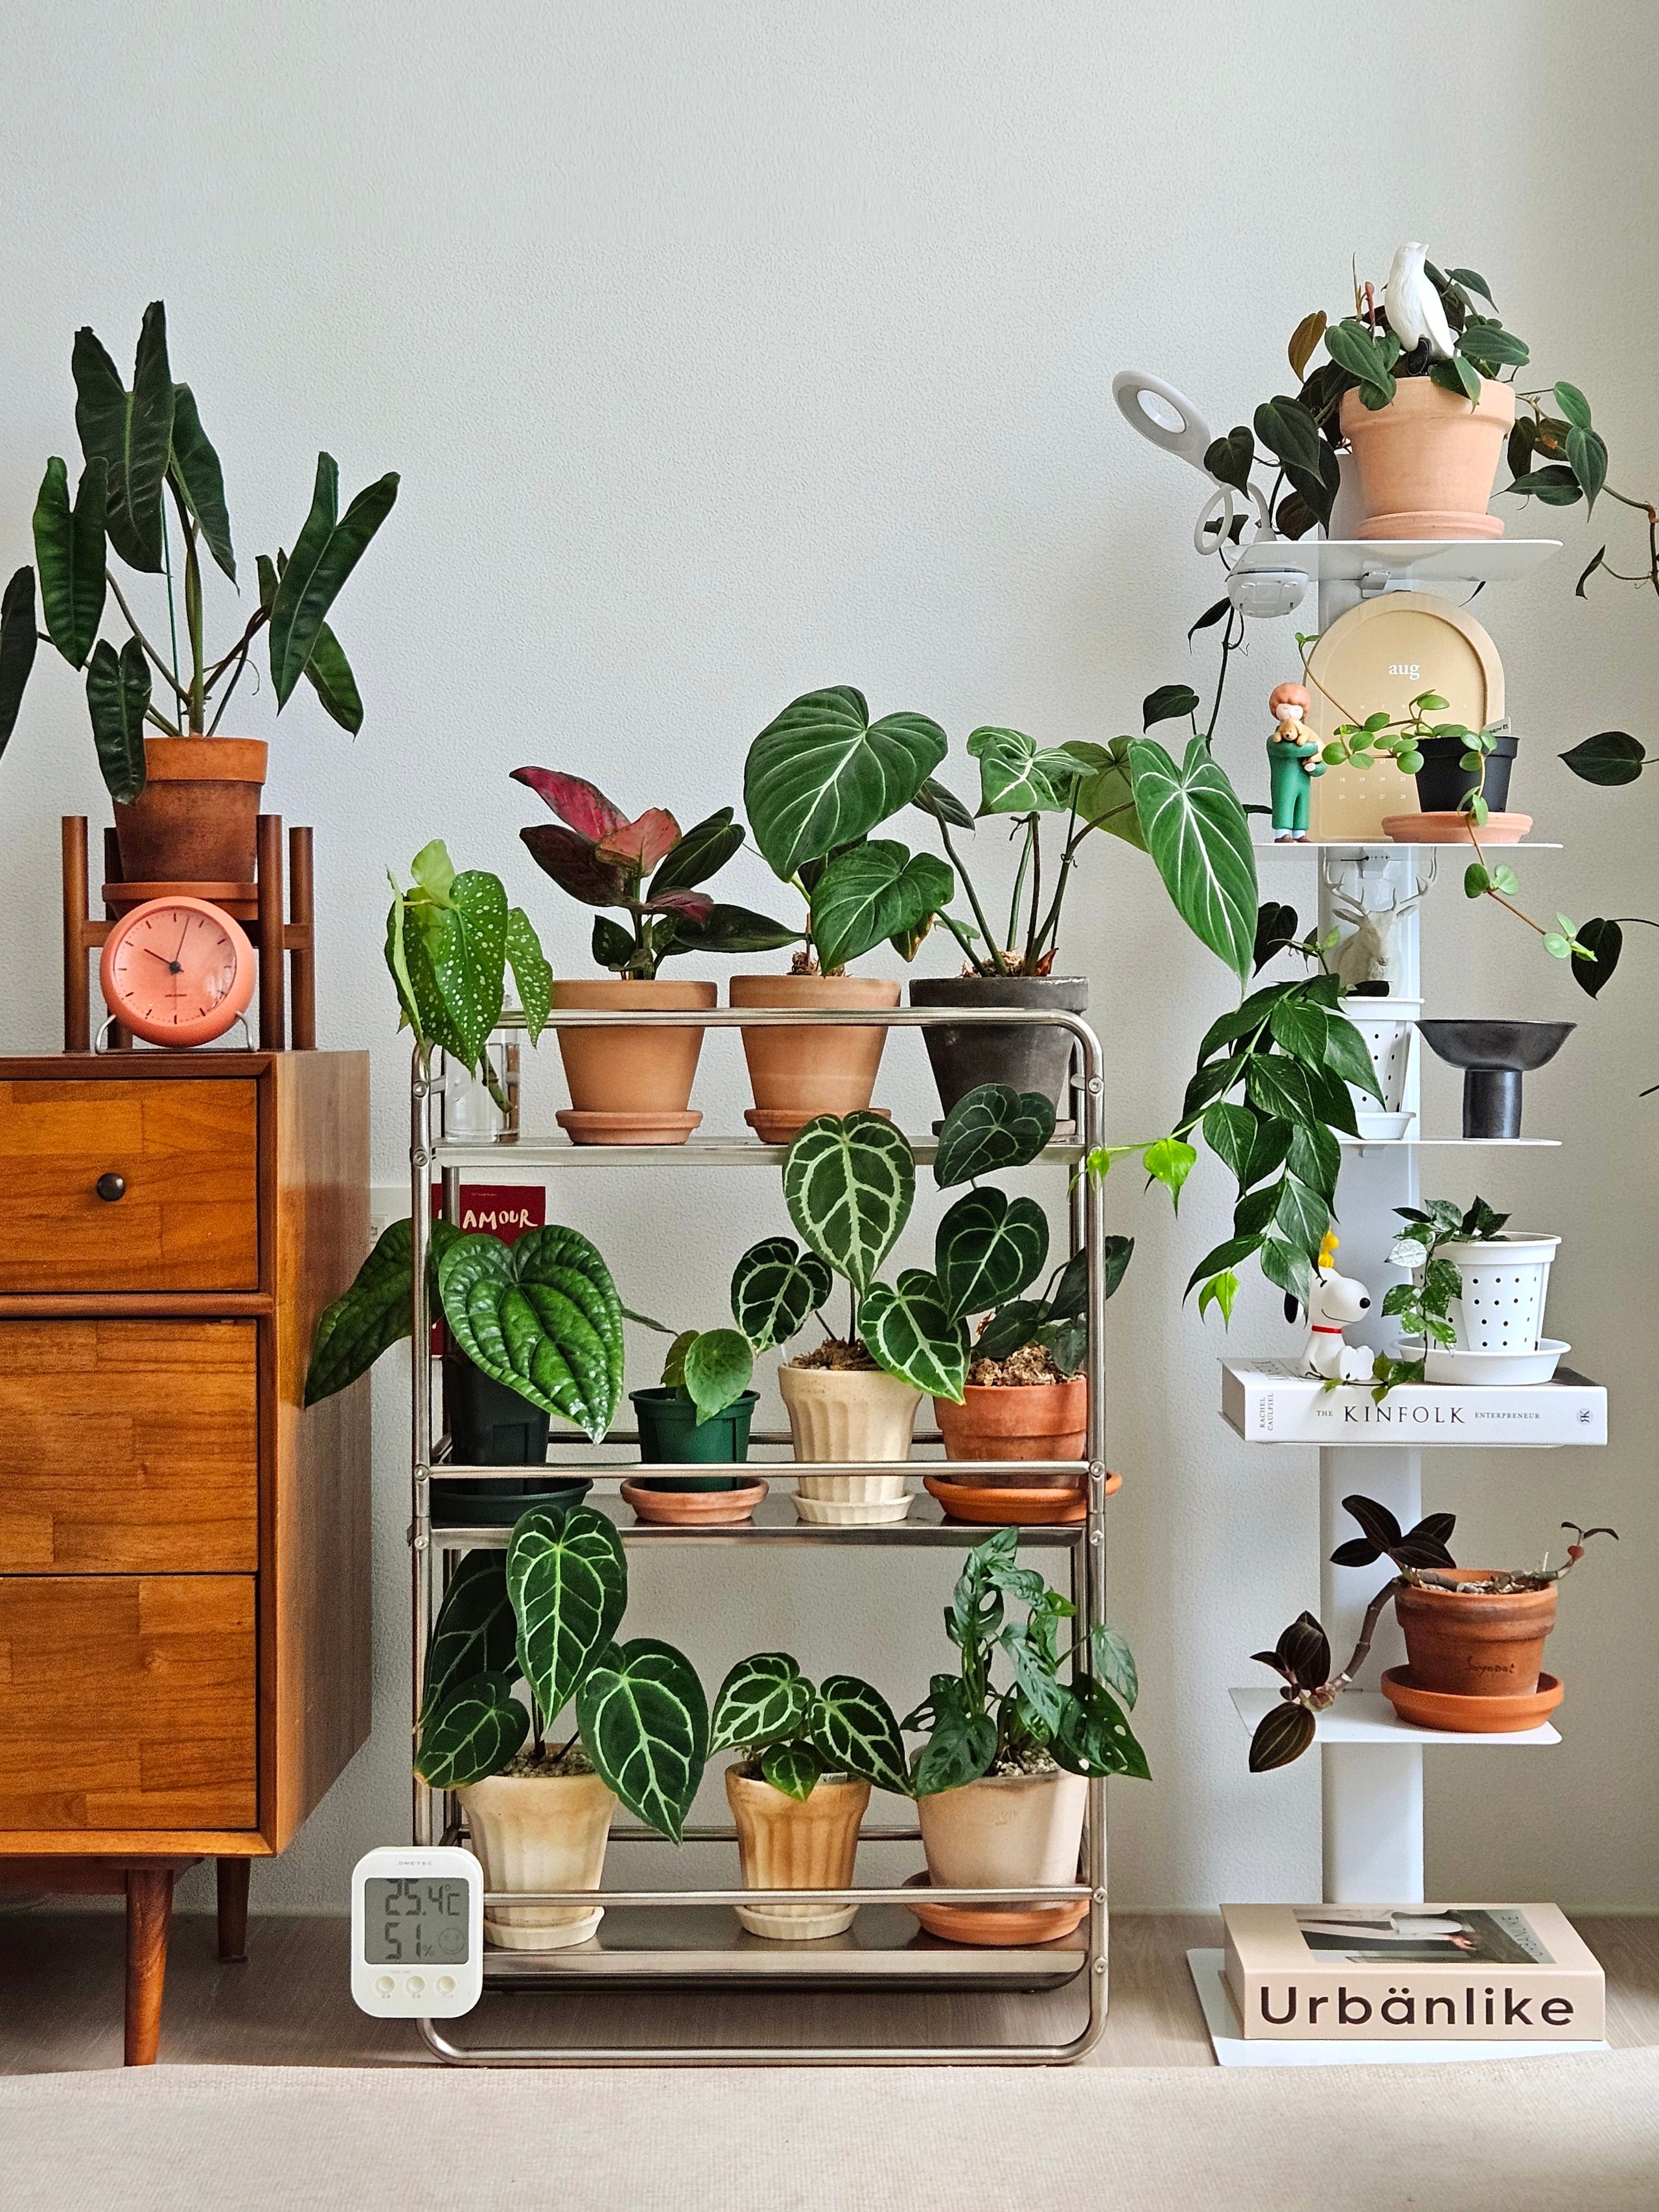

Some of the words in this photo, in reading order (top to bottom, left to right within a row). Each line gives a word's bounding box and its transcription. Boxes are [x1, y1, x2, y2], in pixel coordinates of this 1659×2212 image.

[1388, 663, 1421, 681] aug
[1343, 1405, 1465, 1423] KINFOLK
[1260, 1987, 1575, 2026] Urbänlike
